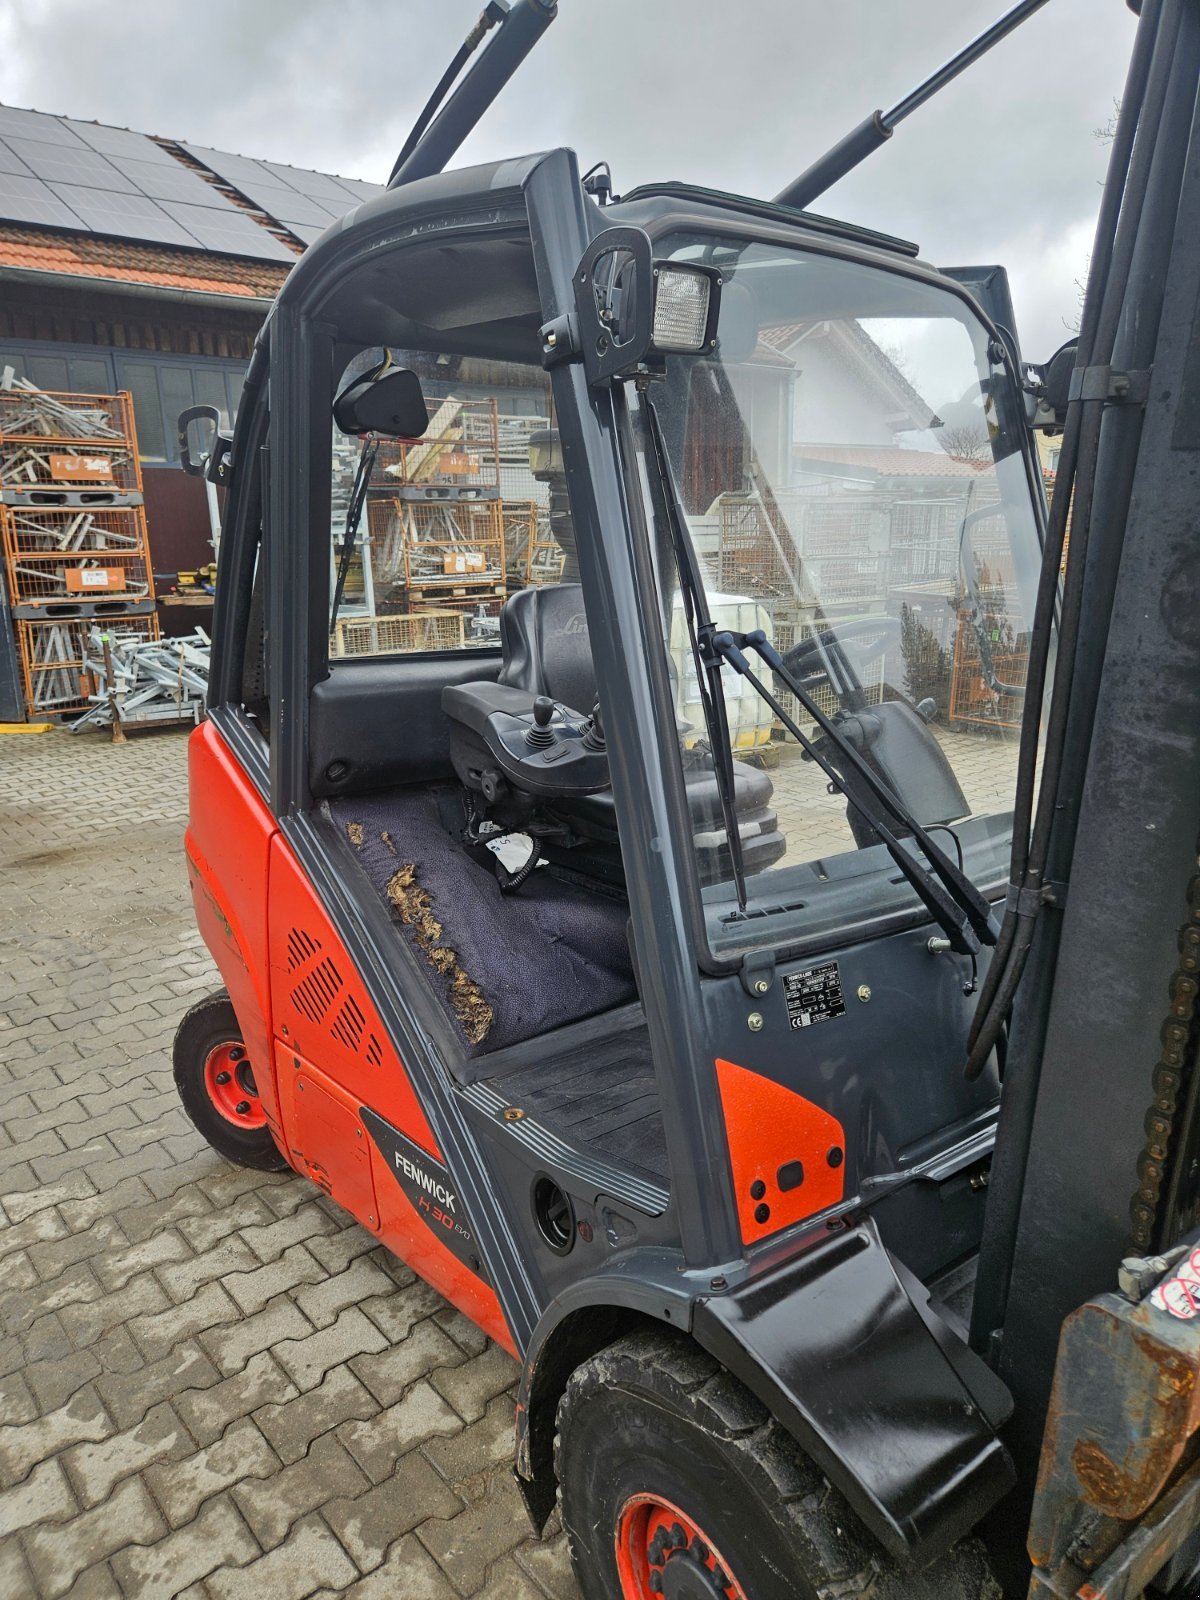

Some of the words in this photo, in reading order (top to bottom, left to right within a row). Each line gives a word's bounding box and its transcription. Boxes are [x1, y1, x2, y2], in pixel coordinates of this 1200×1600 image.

[557, 614, 588, 634] Lin
[792, 1017, 802, 1027] CE
[395, 1152, 456, 1213] FENWICK
[419, 1196, 431, 1212] H
[432, 1206, 454, 1230] 30
